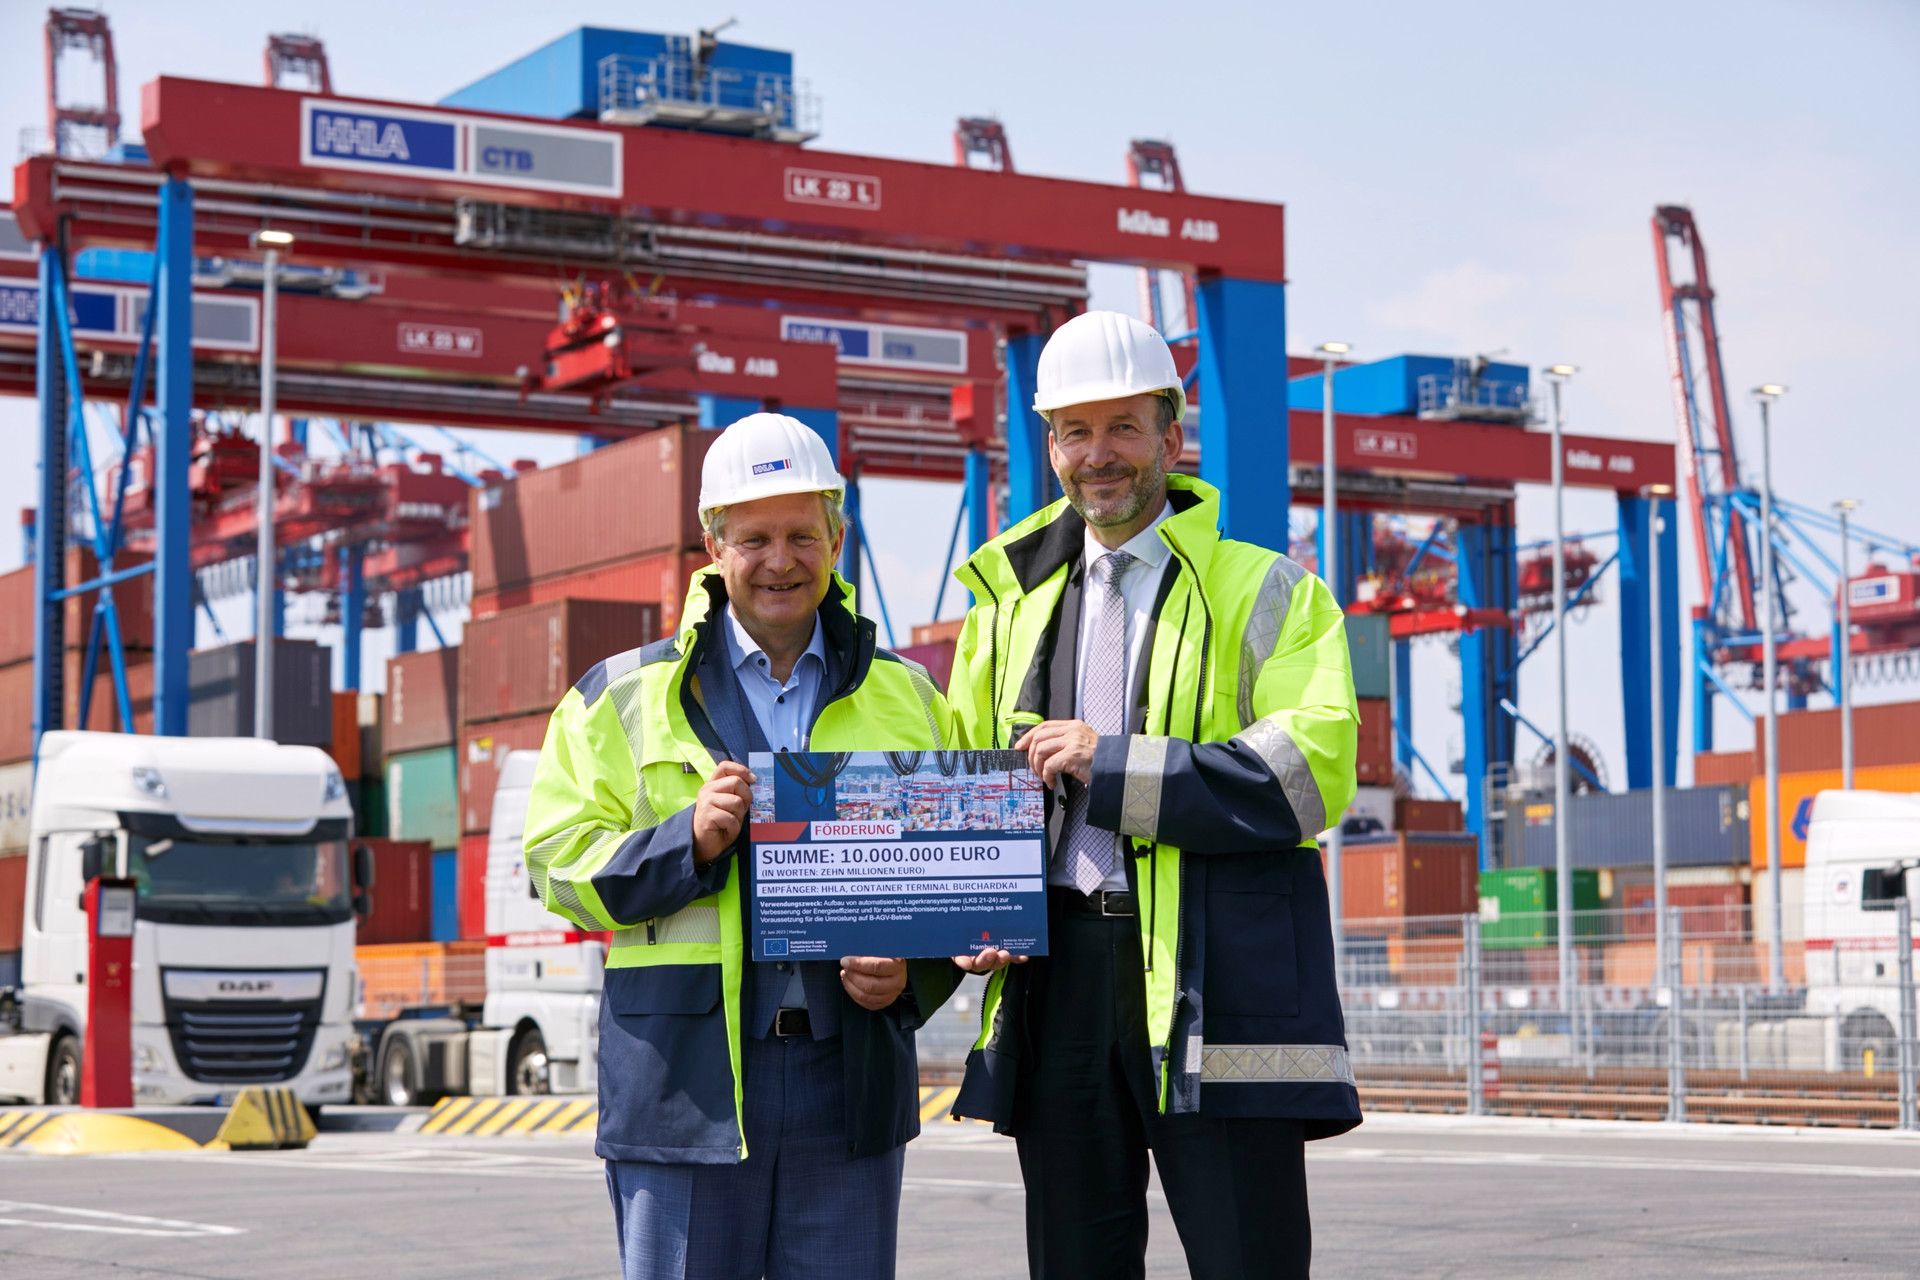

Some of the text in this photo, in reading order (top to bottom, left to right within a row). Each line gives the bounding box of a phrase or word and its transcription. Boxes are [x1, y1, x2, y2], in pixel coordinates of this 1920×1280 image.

[315, 114, 410, 161] HHLA
[482, 145, 534, 172] CTB
[792, 176, 872, 203] LK 23 L
[1180, 217, 1220, 243] ABB
[814, 823, 895, 836] FÖRDERUNG
[762, 846, 1001, 865] SUMME: 10.000.000 EURO
[761, 866, 926, 877] (IN WORTEN: ZEHN MILLIONEN EURO)
[761, 882, 1018, 895] EMPFÄNGER: HHLA, CONTAINER TERMINAL BURCHARDKAI
[760, 900, 823, 908] Verwendungszweck:
[904, 897, 962, 905] Lagerkransystemen
[760, 908, 801, 916] Verbesserung
[813, 907, 860, 915] Energieeffizienz
[896, 905, 948, 913] Dekarbonisierung
[961, 905, 995, 913] Umschlags
[760, 916, 804, 924] Voraussetzung
[825, 915, 857, 923] Umrüstung
[218, 980, 274, 993] DAF
